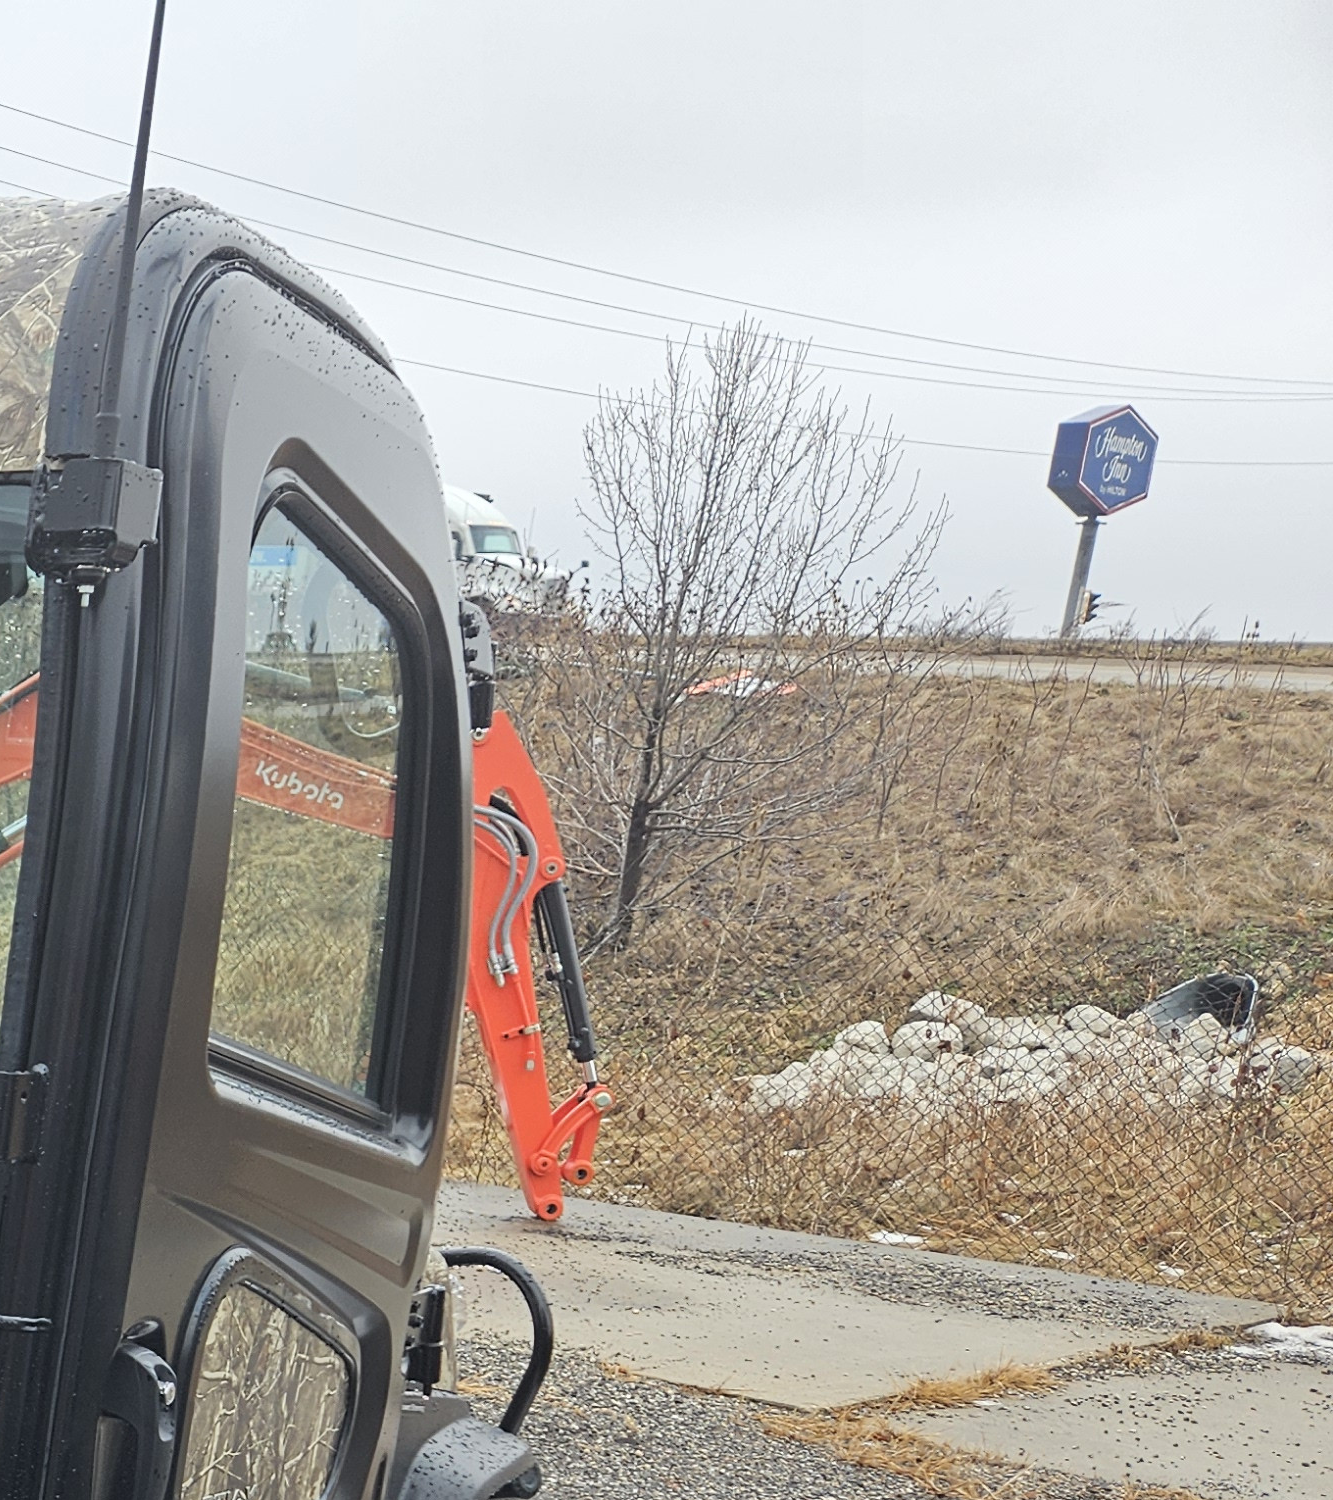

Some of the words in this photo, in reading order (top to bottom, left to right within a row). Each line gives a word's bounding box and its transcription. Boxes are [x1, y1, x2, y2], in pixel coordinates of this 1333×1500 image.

[1095, 426, 1148, 462] Hampton
[1102, 455, 1131, 483] Inn
[255, 760, 344, 809] Kubota
